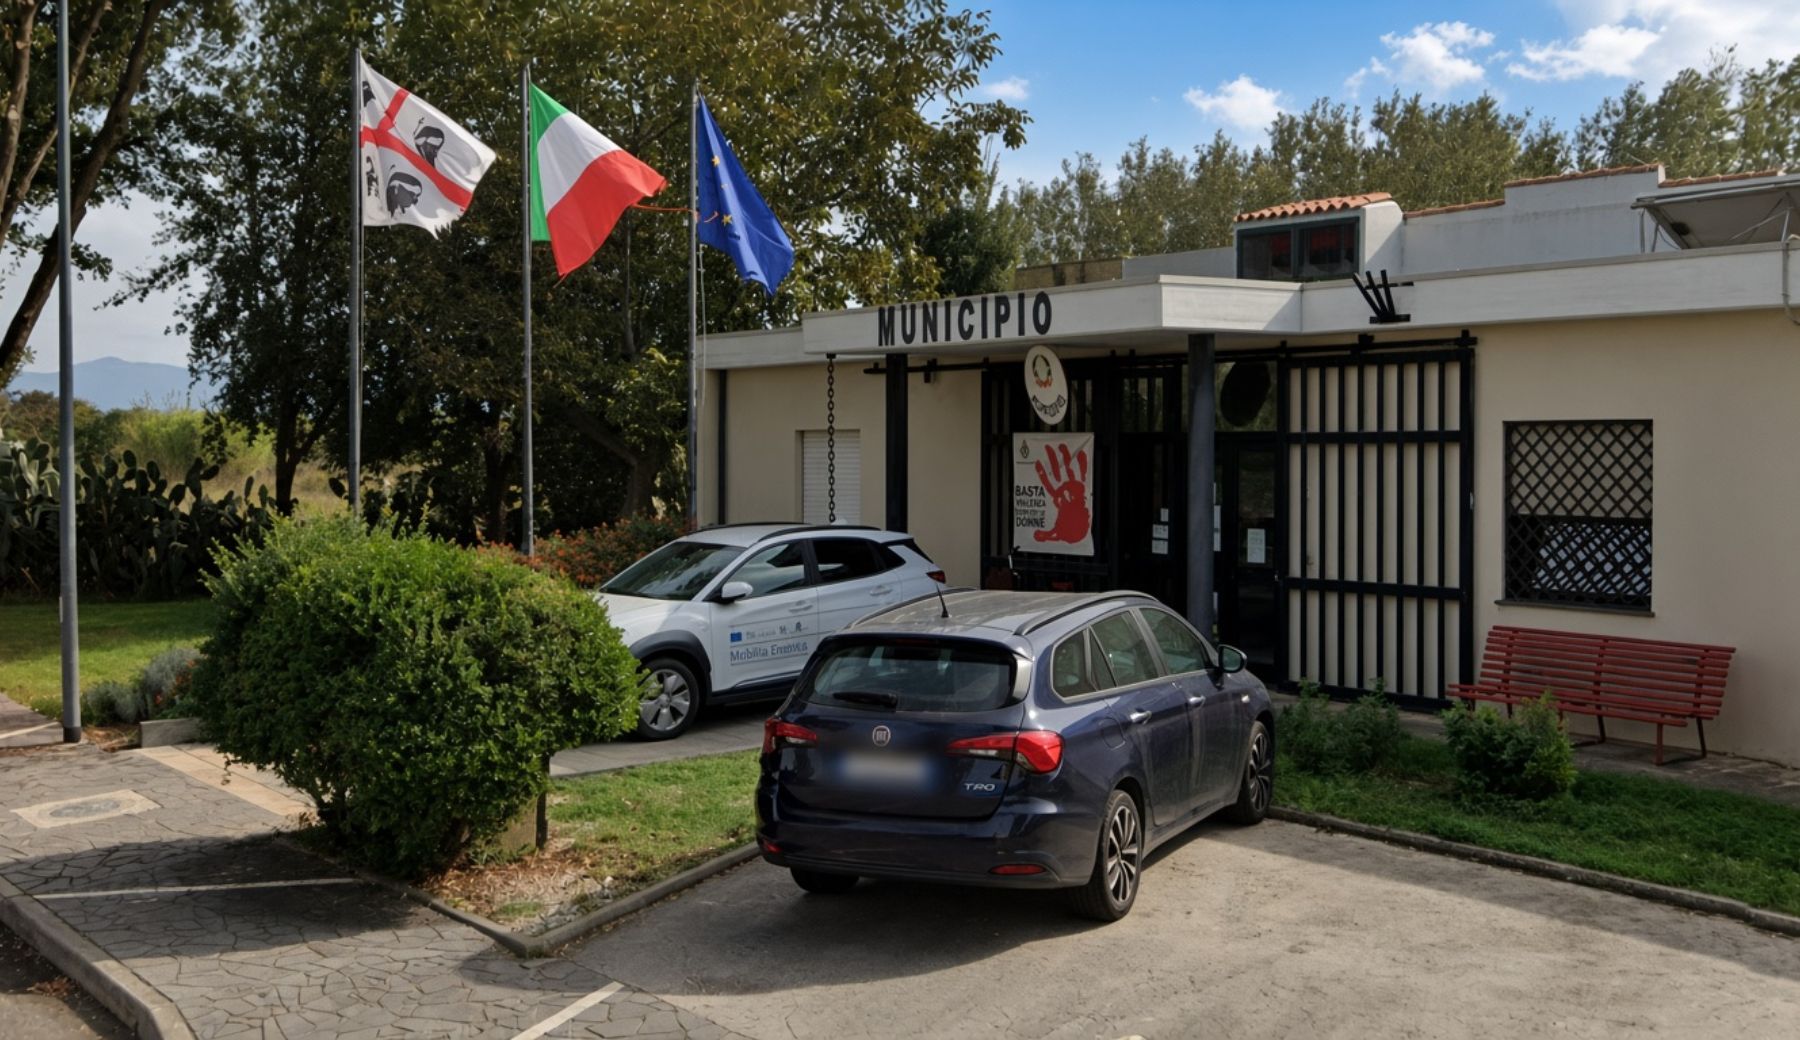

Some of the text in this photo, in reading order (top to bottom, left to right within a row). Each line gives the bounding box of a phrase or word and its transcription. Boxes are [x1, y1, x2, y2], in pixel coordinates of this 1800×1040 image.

[878, 291, 1052, 347] MUNICIPIO
[1015, 485, 1046, 497] BASTA
[1016, 516, 1045, 528] DONNE
